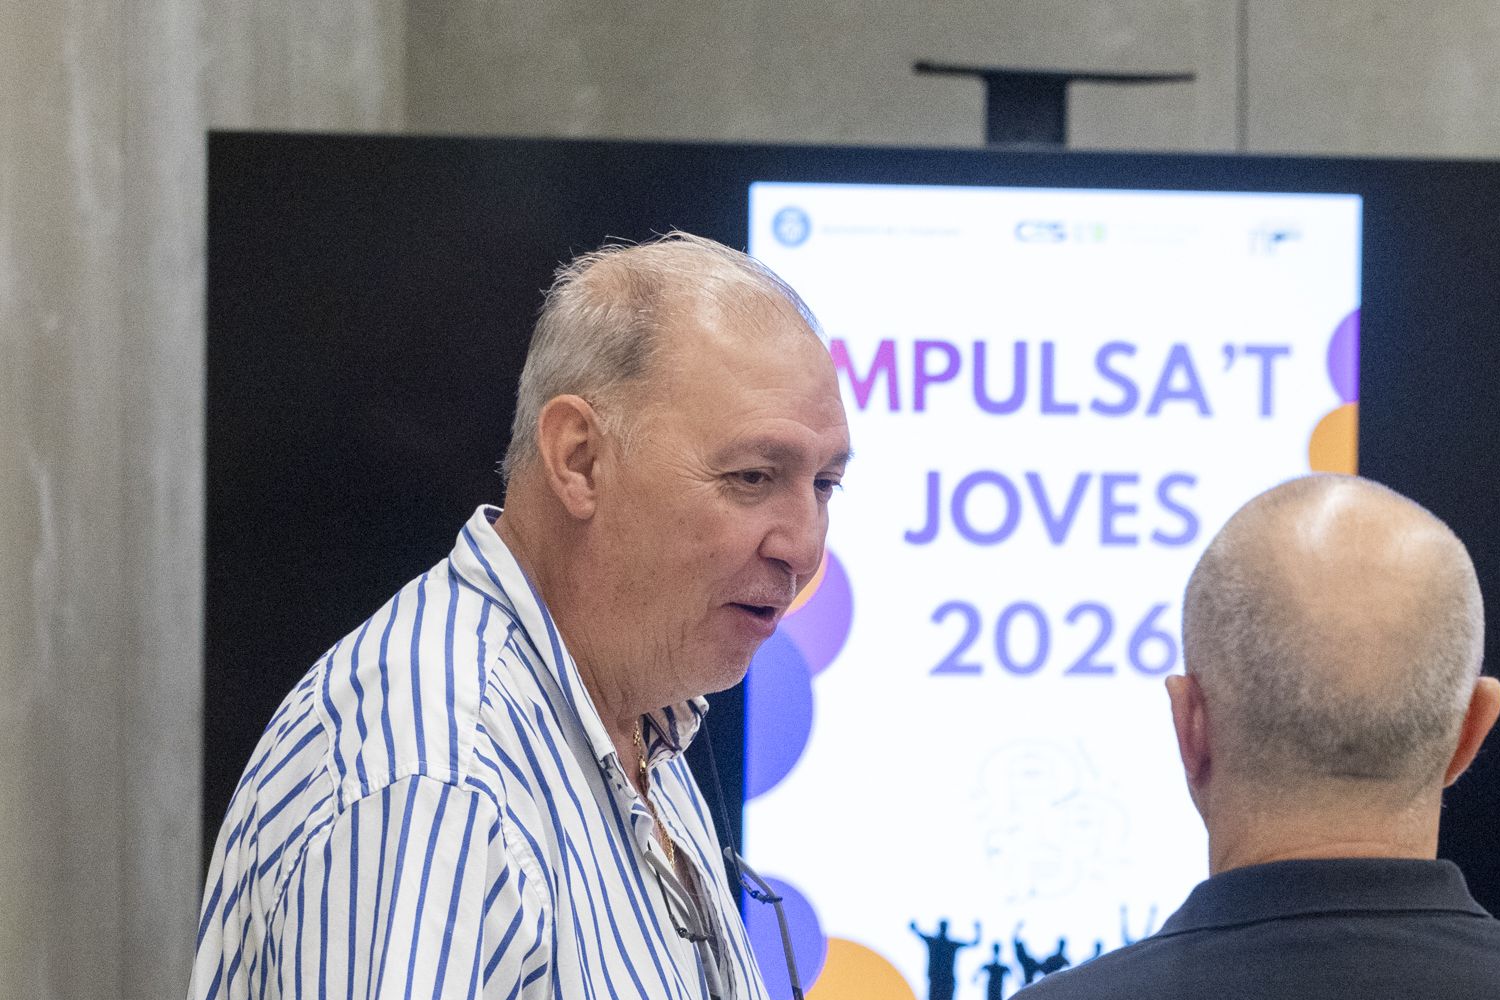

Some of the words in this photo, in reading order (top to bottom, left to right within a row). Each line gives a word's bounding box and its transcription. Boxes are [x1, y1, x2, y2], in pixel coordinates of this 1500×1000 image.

[829, 337, 1292, 419] MPULSA’T
[902, 468, 1201, 547] JOVES
[928, 600, 1178, 677] 2026
